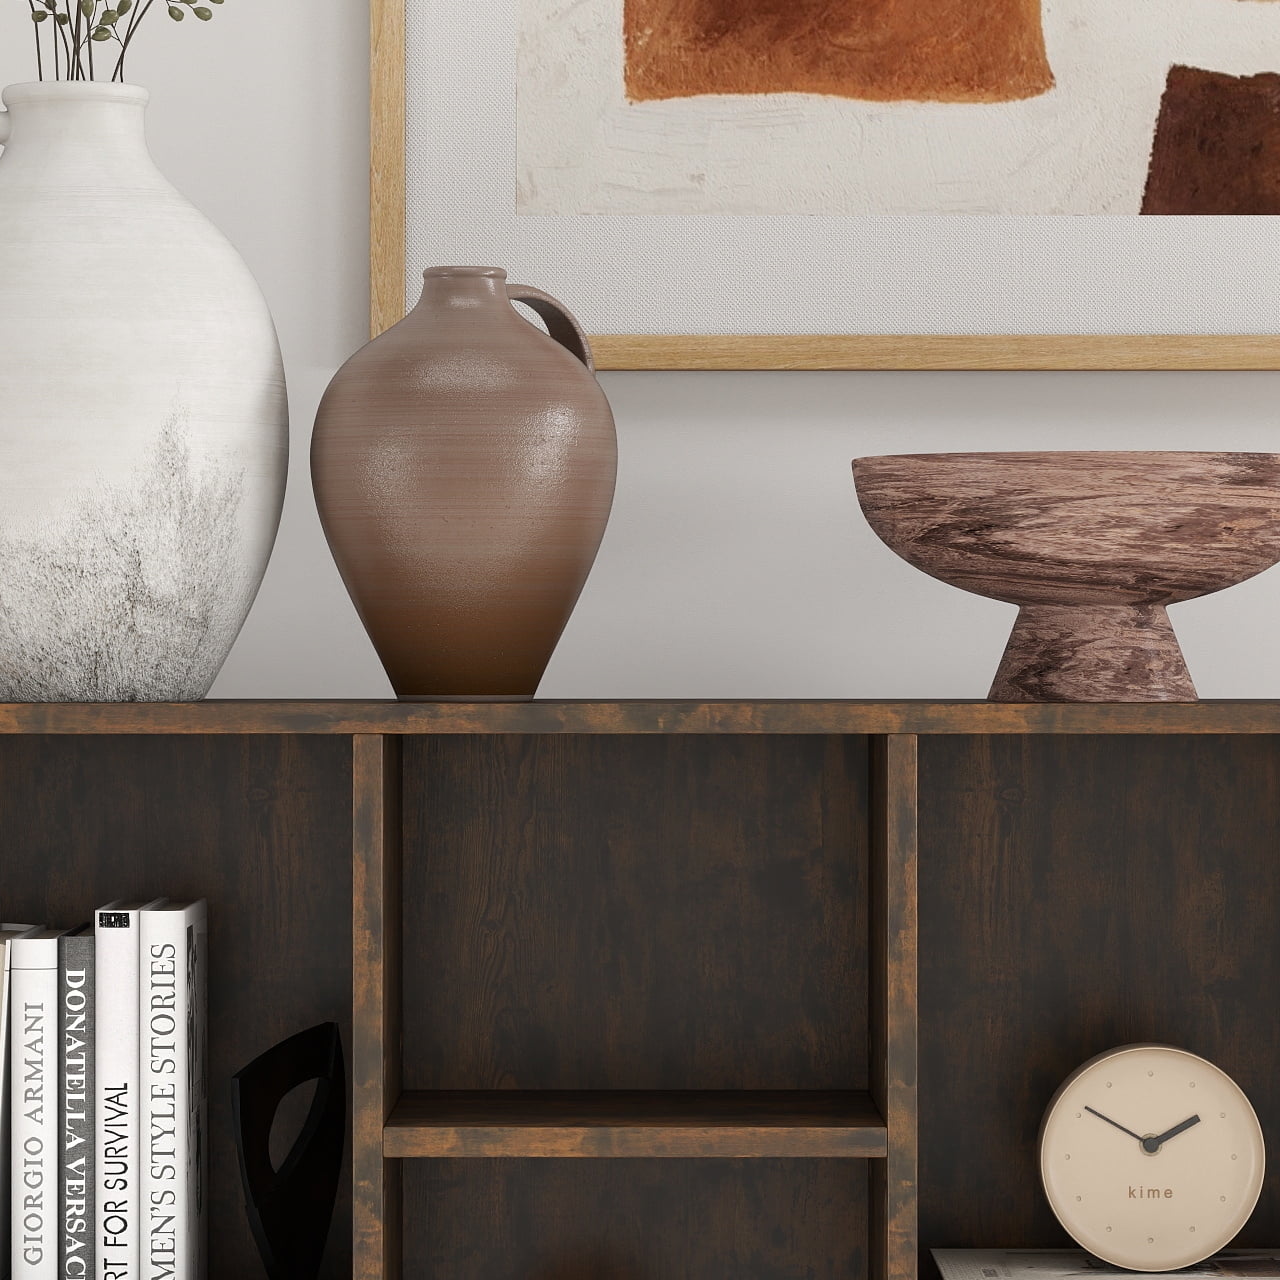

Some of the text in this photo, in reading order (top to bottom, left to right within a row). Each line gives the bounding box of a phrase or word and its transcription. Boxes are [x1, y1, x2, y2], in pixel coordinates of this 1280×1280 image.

[65, 967, 87, 1151] DONATELLA
[150, 943, 176, 1074] STORIES
[23, 1002, 44, 1266] GIORGIO ARMANI
[103, 1082, 129, 1191] SURVIVAL
[150, 1083, 176, 1180] STYLE
[103, 1199, 129, 1247] FOR
[1128, 1185, 1174, 1199] kime
